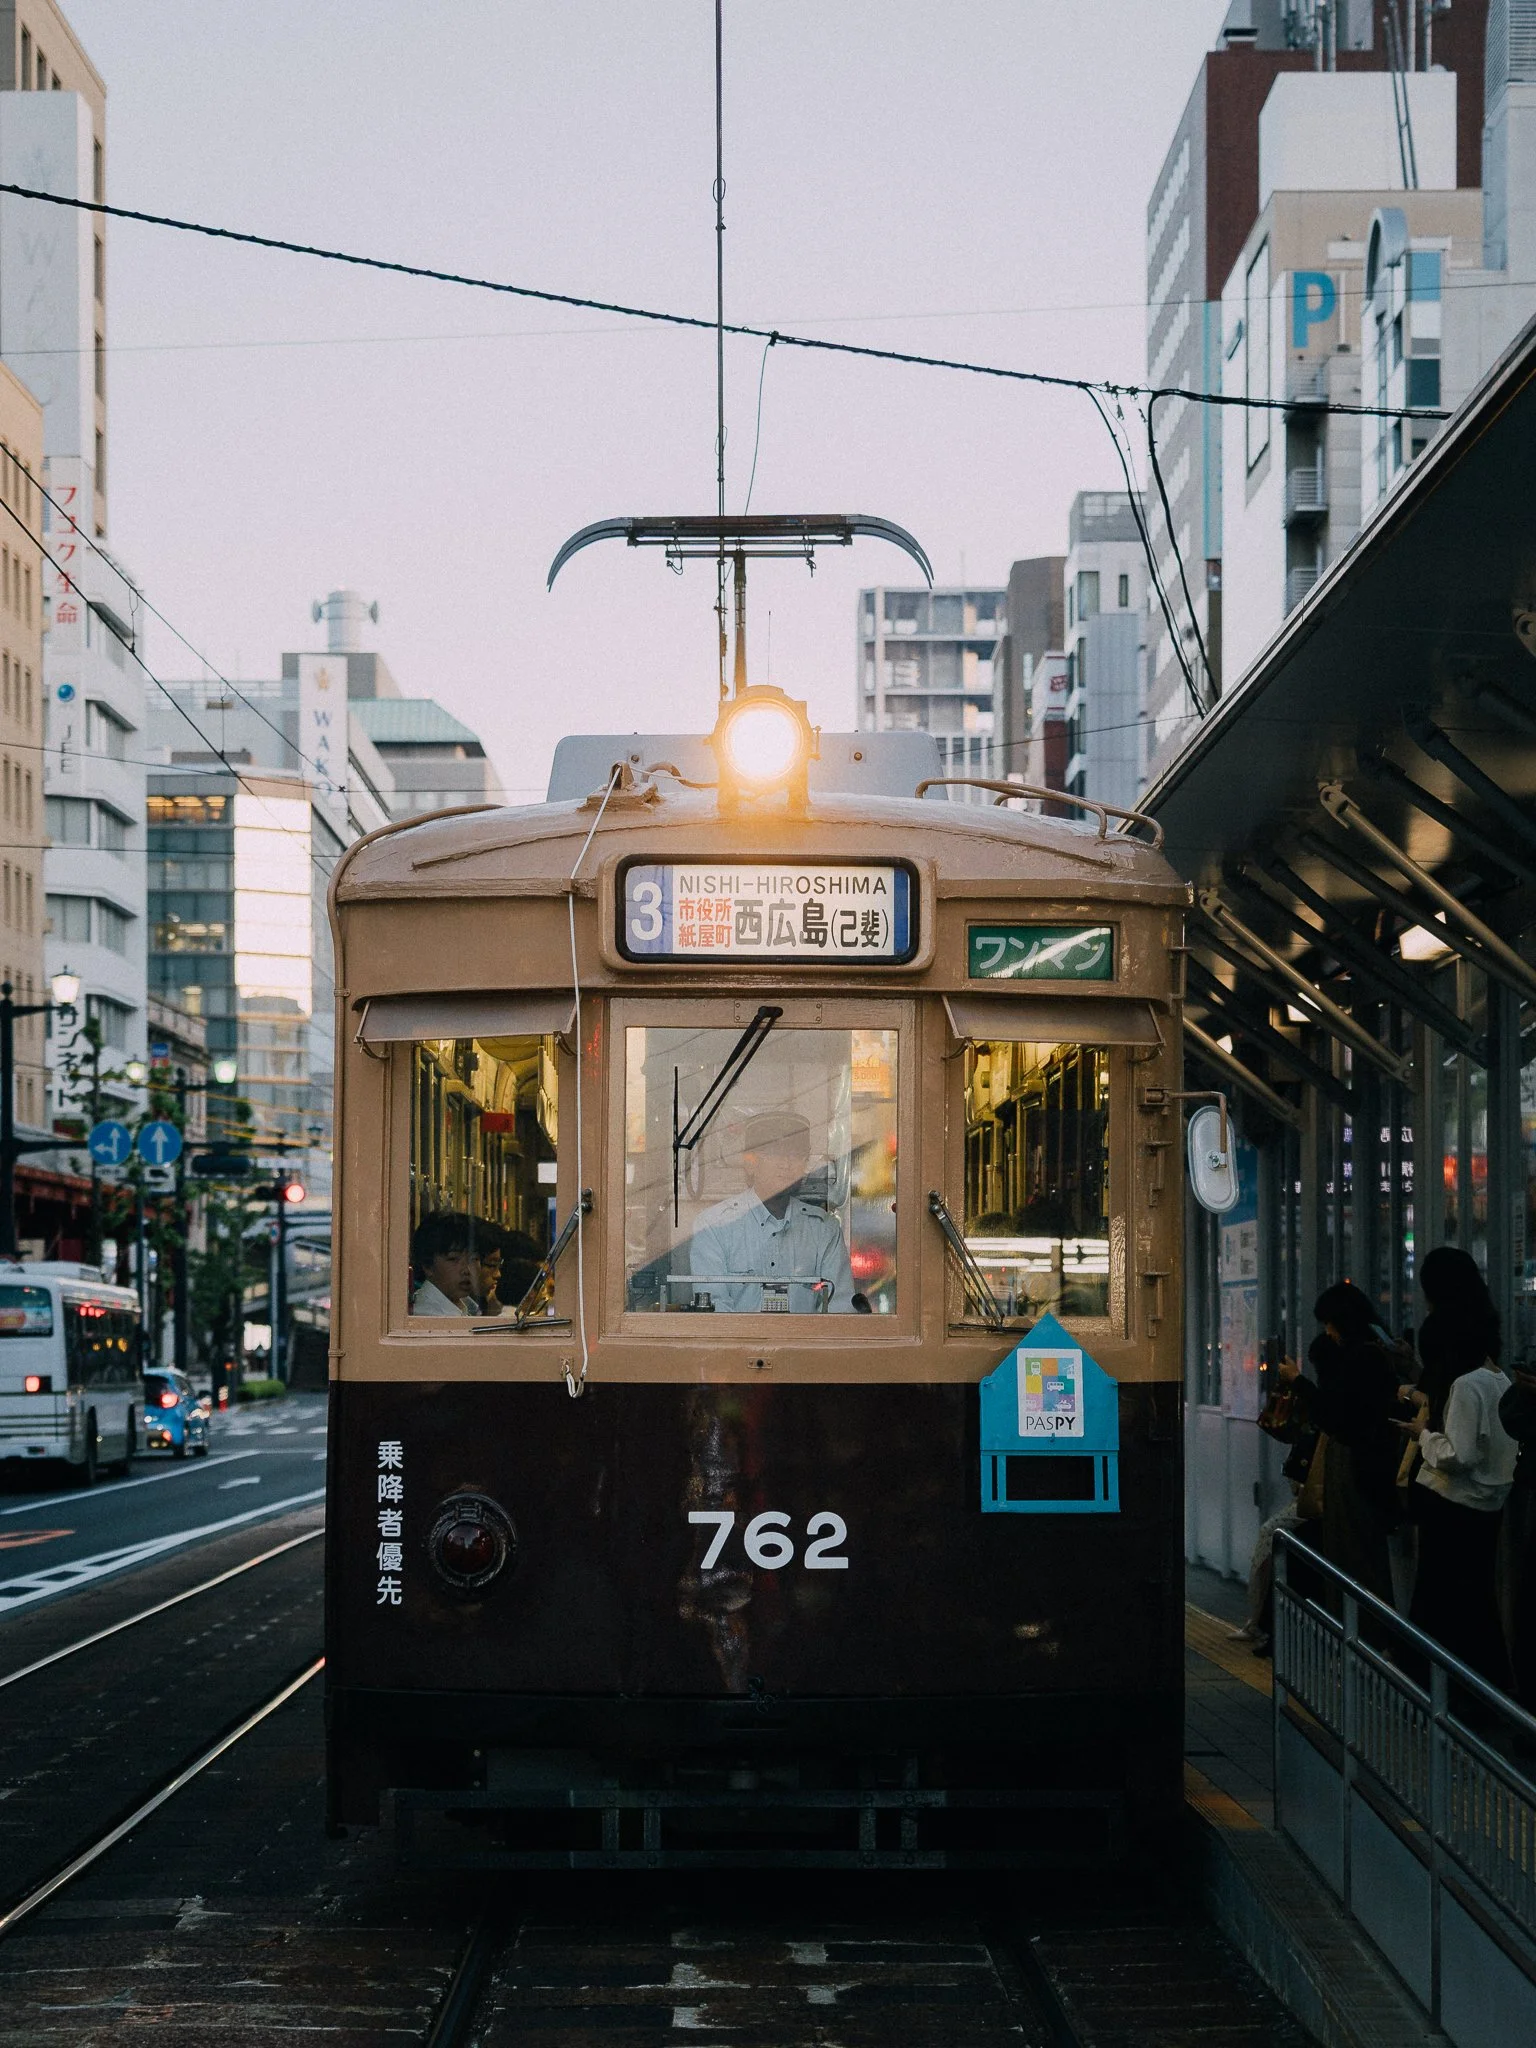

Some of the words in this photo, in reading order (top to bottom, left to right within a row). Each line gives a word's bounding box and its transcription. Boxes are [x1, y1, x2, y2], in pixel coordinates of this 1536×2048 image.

[1293, 271, 1336, 348] P
[56, 486, 79, 624] フコク生命
[679, 874, 888, 895] NISHI-HIROSHIMA
[631, 881, 664, 942] 3
[678, 897, 733, 923] 市役所
[678, 924, 733, 949] 紙屋町
[976, 936, 1106, 971] ワンマン
[1026, 1416, 1076, 1431] PASPY
[376, 1440, 404, 1605] 乗降者優先
[688, 1511, 849, 1570] 762
